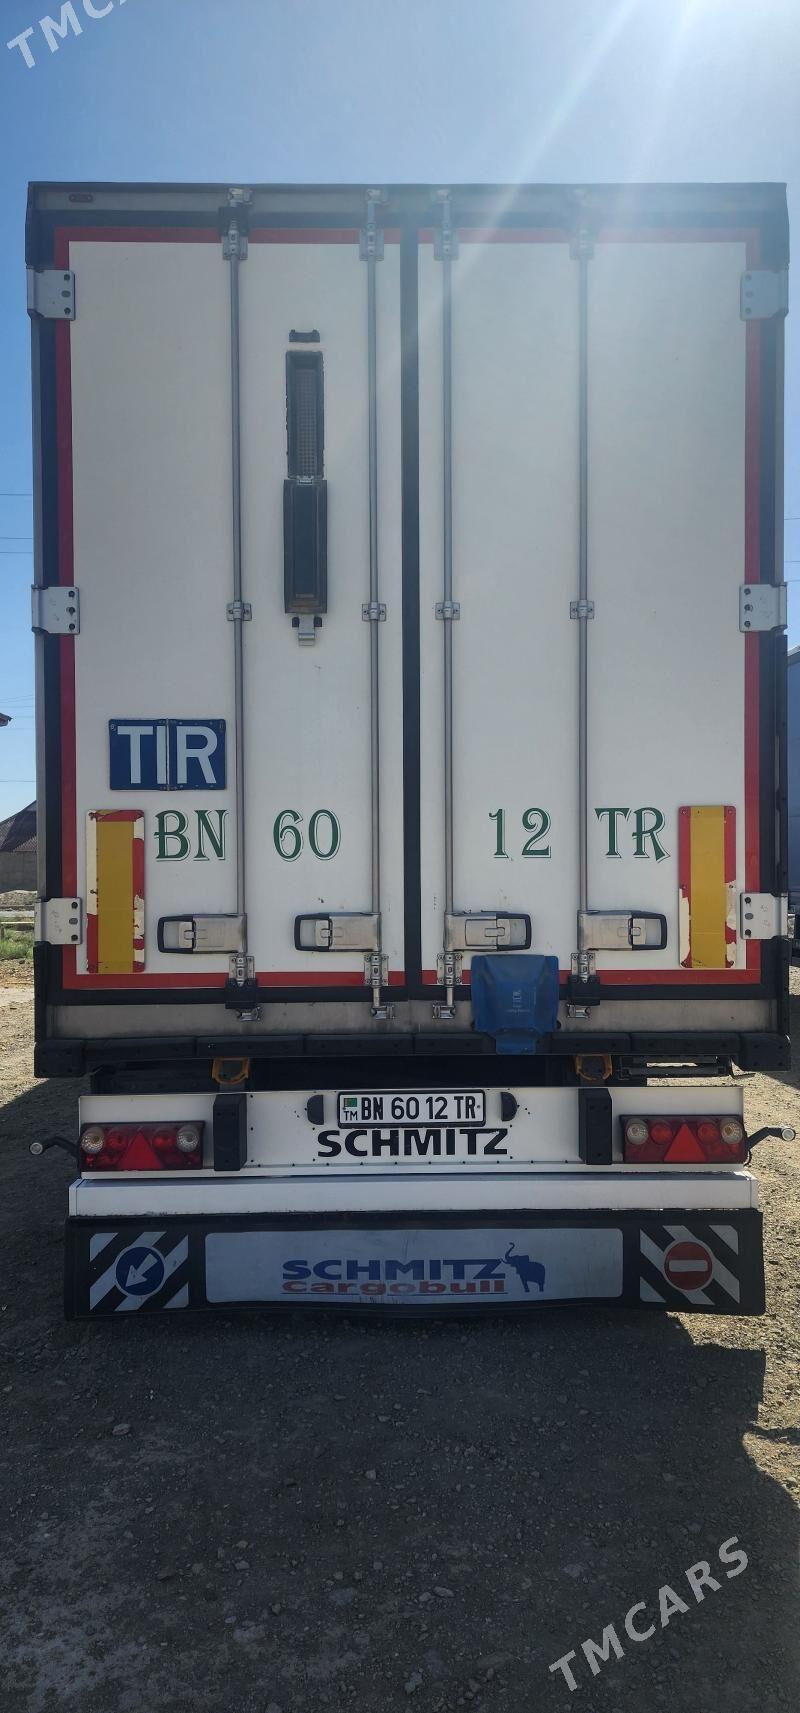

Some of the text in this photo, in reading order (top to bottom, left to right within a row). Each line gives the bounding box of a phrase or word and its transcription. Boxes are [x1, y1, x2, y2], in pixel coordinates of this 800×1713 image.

[117, 725, 218, 784] TIR
[154, 806, 671, 863] BN 60 12 TR
[343, 1110, 358, 1121] TM
[361, 1095, 476, 1121] BN 60 12 TR
[317, 1128, 508, 1158] SCHMITZ
[282, 1258, 506, 1281] SCHMITZ
